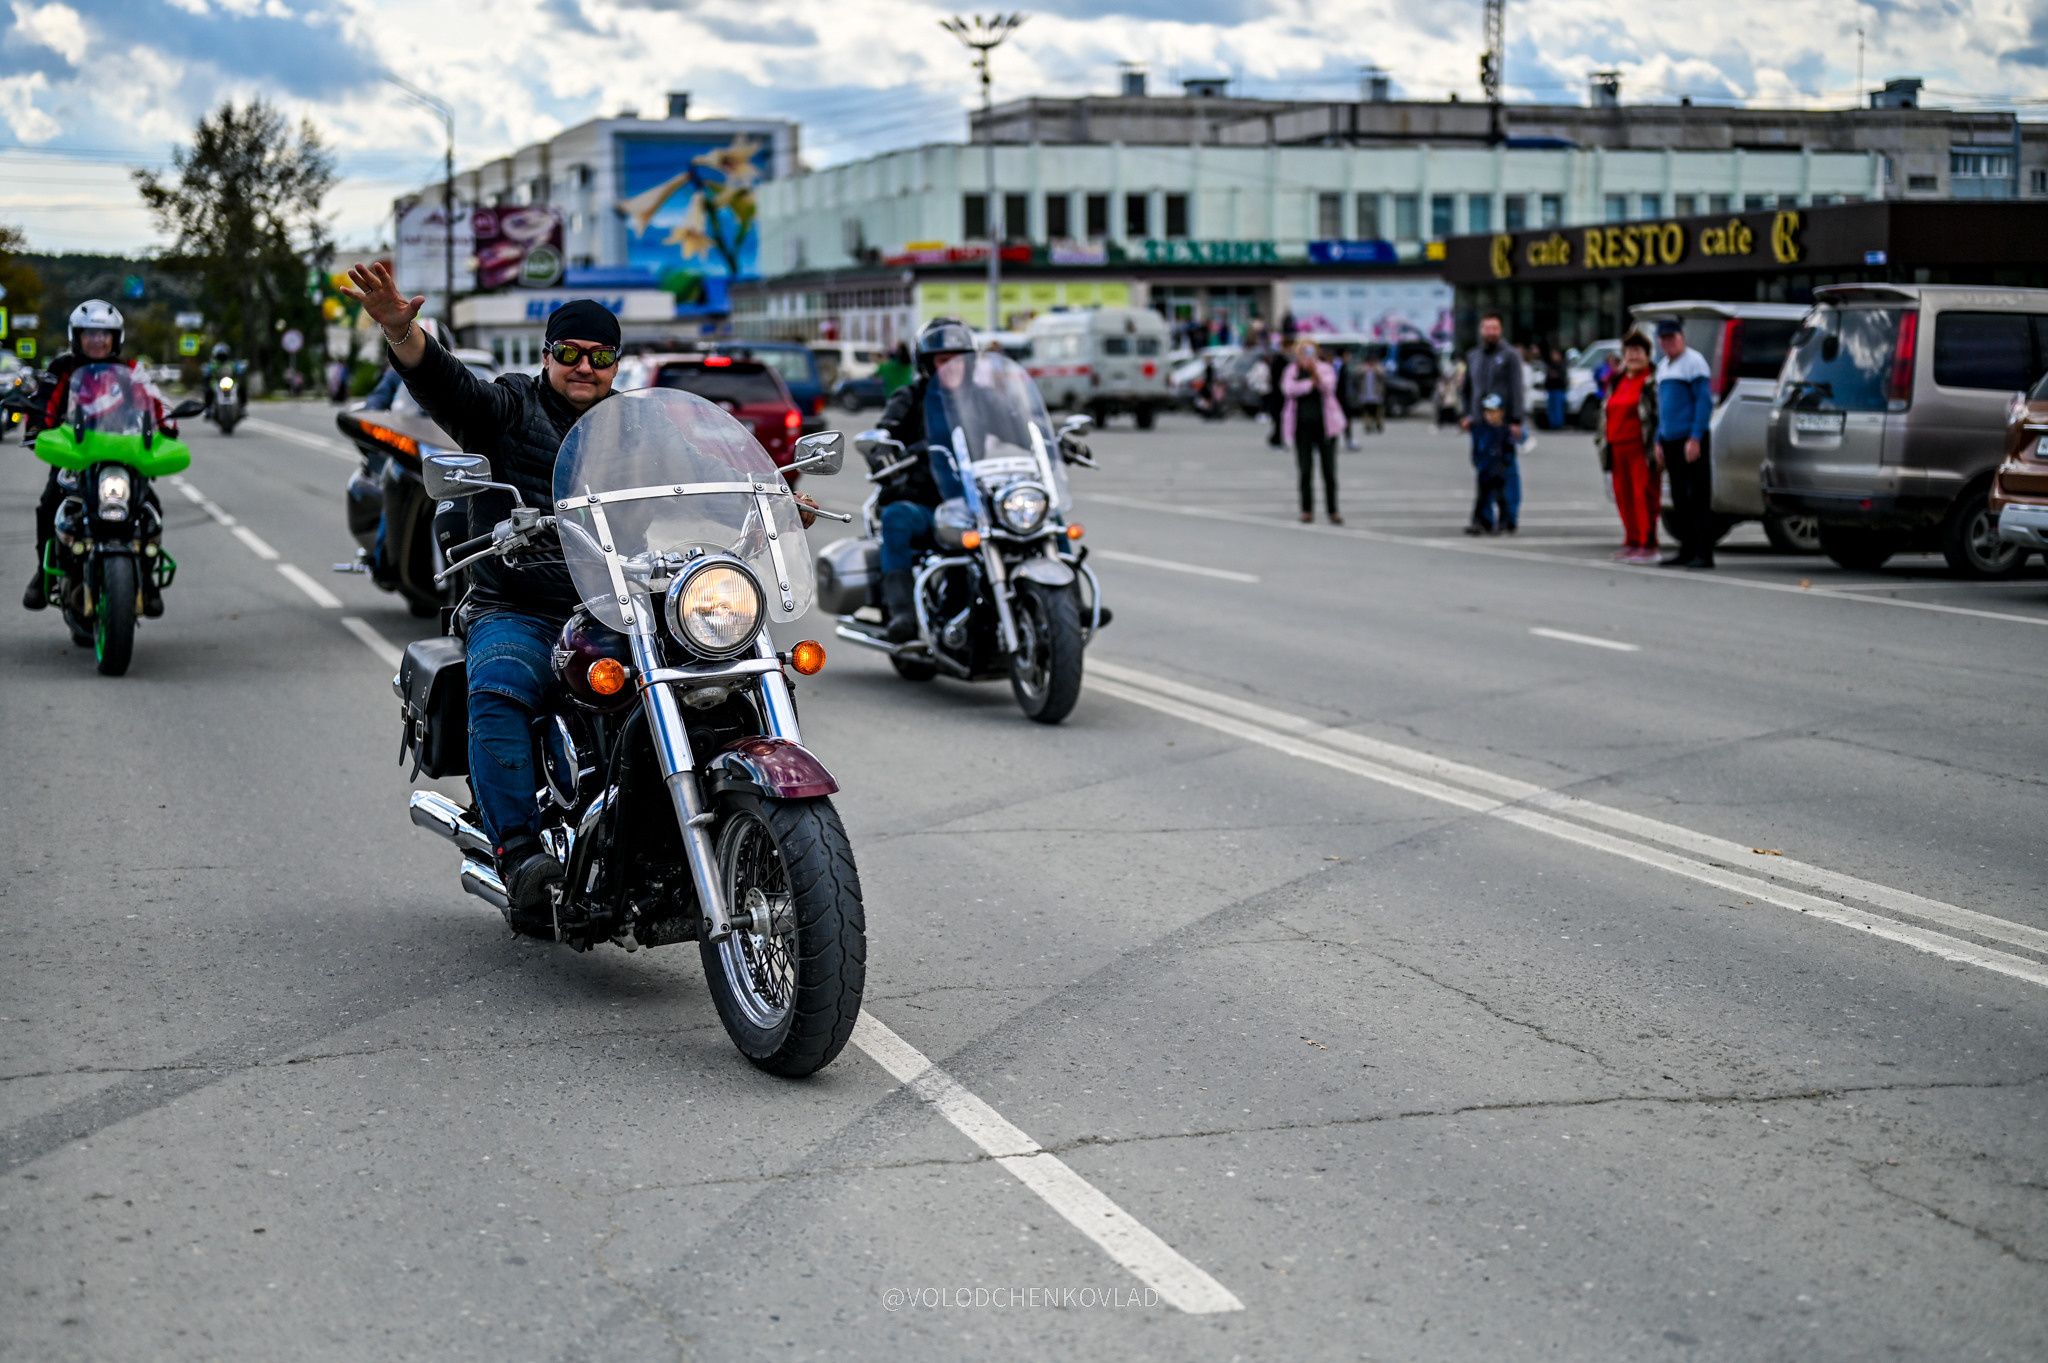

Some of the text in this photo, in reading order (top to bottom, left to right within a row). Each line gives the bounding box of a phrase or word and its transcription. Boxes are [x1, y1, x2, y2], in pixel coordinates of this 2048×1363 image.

[1527, 233, 1571, 266] cafe
[1583, 222, 1684, 269] RESTO
[1700, 218, 1752, 257] cafe
